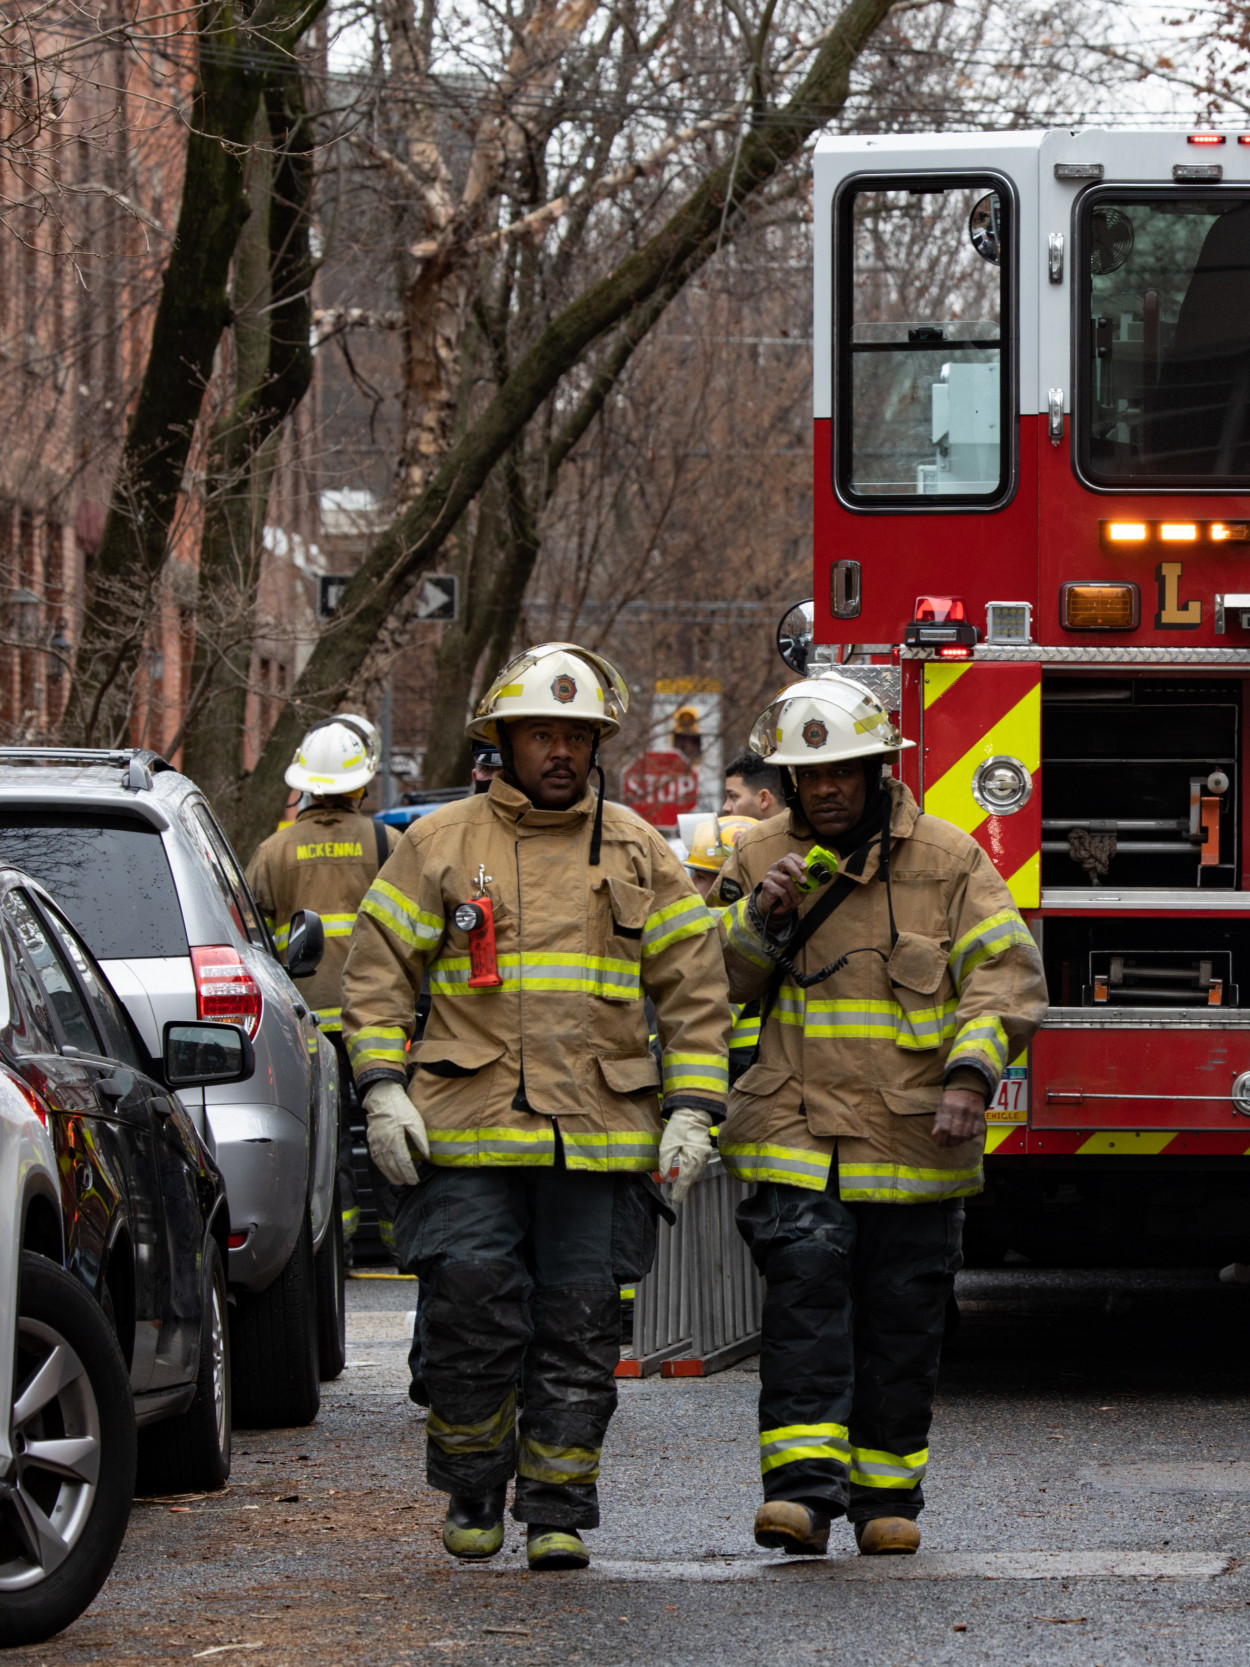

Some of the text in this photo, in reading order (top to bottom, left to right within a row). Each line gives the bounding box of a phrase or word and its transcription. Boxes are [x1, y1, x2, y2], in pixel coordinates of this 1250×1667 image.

[1154, 562, 1201, 630] L
[627, 774, 695, 803] STOP
[297, 842, 363, 860] MCKENNA
[989, 1081, 1022, 1110] 47
[986, 1111, 1020, 1120] EHICLE
